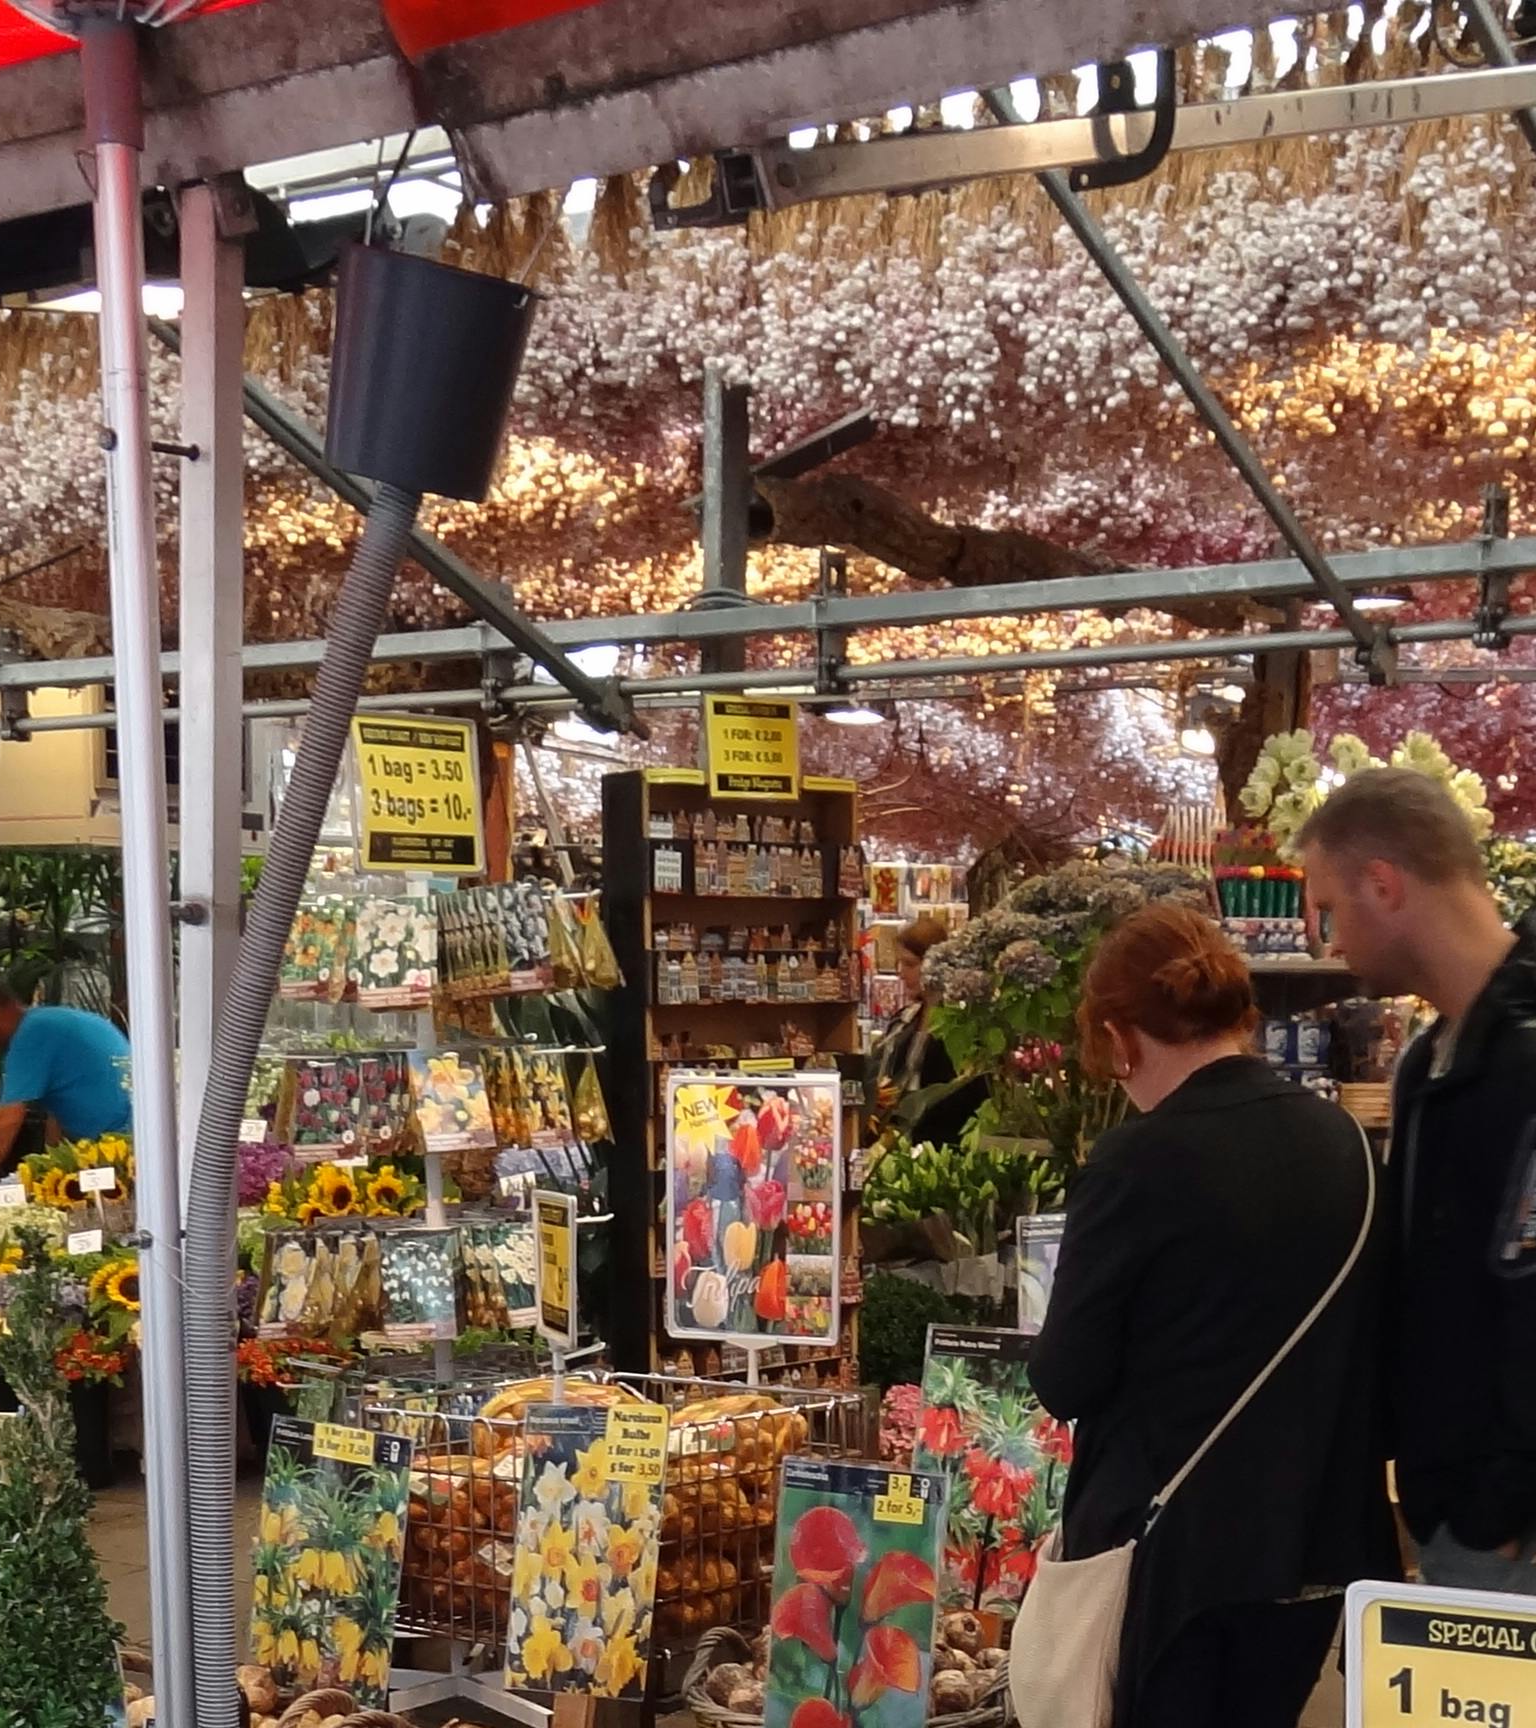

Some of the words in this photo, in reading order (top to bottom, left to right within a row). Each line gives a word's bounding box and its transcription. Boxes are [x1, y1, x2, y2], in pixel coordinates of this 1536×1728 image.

[368, 754, 377, 776] 1
[381, 754, 413, 784] bag
[430, 759, 463, 782] 3.50
[371, 788, 381, 815] 3
[386, 789, 425, 825] bags
[444, 794, 471, 821] 10.-
[683, 1095, 720, 1120] NEW
[618, 1462, 635, 1473] for
[892, 1476, 907, 1492] 3,-
[877, 1500, 885, 1513] 2
[887, 1502, 904, 1513] for
[905, 1503, 921, 1518] 5,-
[1429, 1620, 1525, 1651] SPECIAL
[1388, 1667, 1413, 1715] 1
